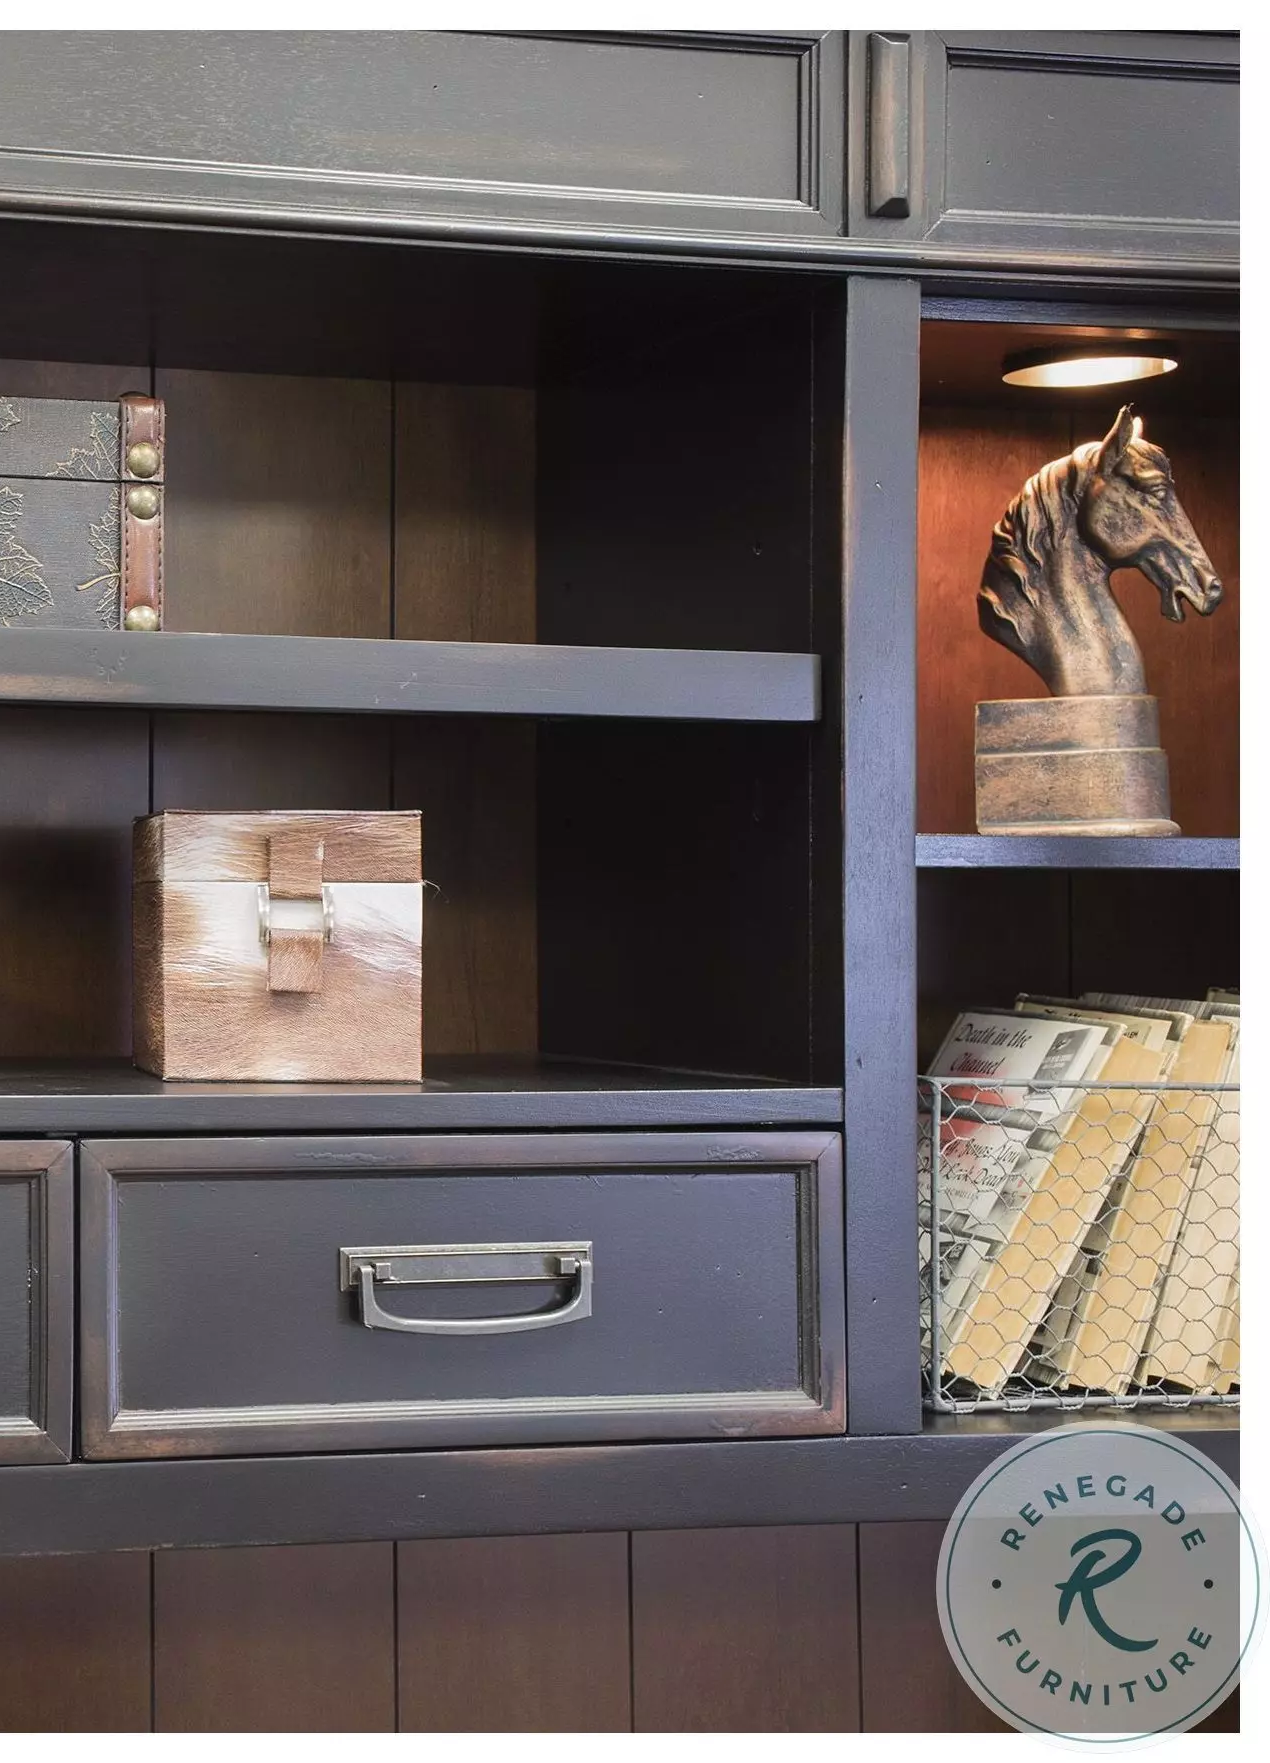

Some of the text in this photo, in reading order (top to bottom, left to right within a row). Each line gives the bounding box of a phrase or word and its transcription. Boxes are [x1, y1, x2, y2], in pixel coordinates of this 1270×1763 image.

[955, 1024, 1032, 1048] Death in the
[950, 1052, 1006, 1076] Channel
